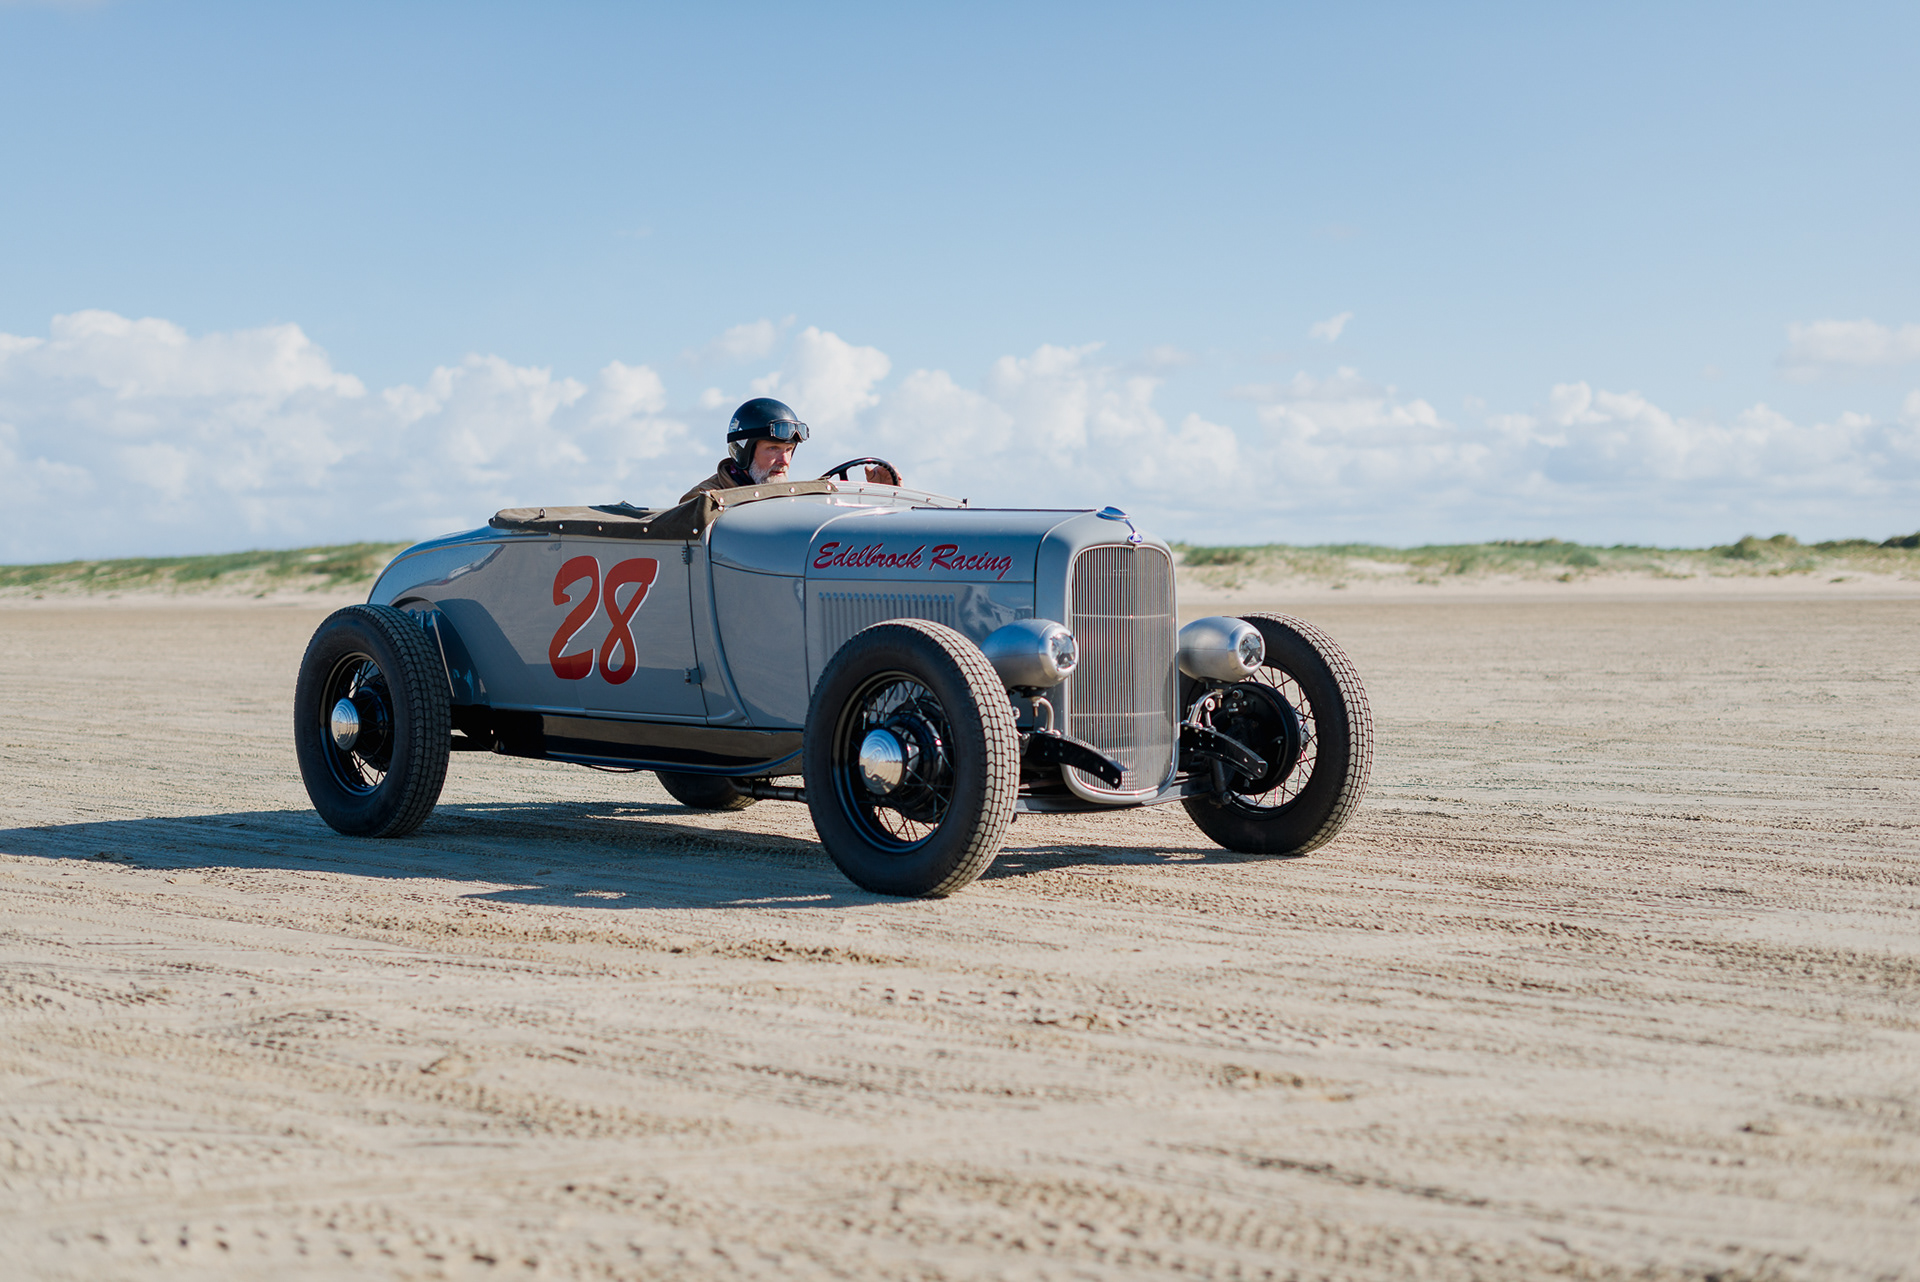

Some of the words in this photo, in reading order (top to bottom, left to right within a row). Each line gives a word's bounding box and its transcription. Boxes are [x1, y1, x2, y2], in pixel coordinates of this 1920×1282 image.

[813, 542, 926, 569] Edelbrock
[930, 543, 1013, 581] Racing
[548, 555, 659, 685] 28
